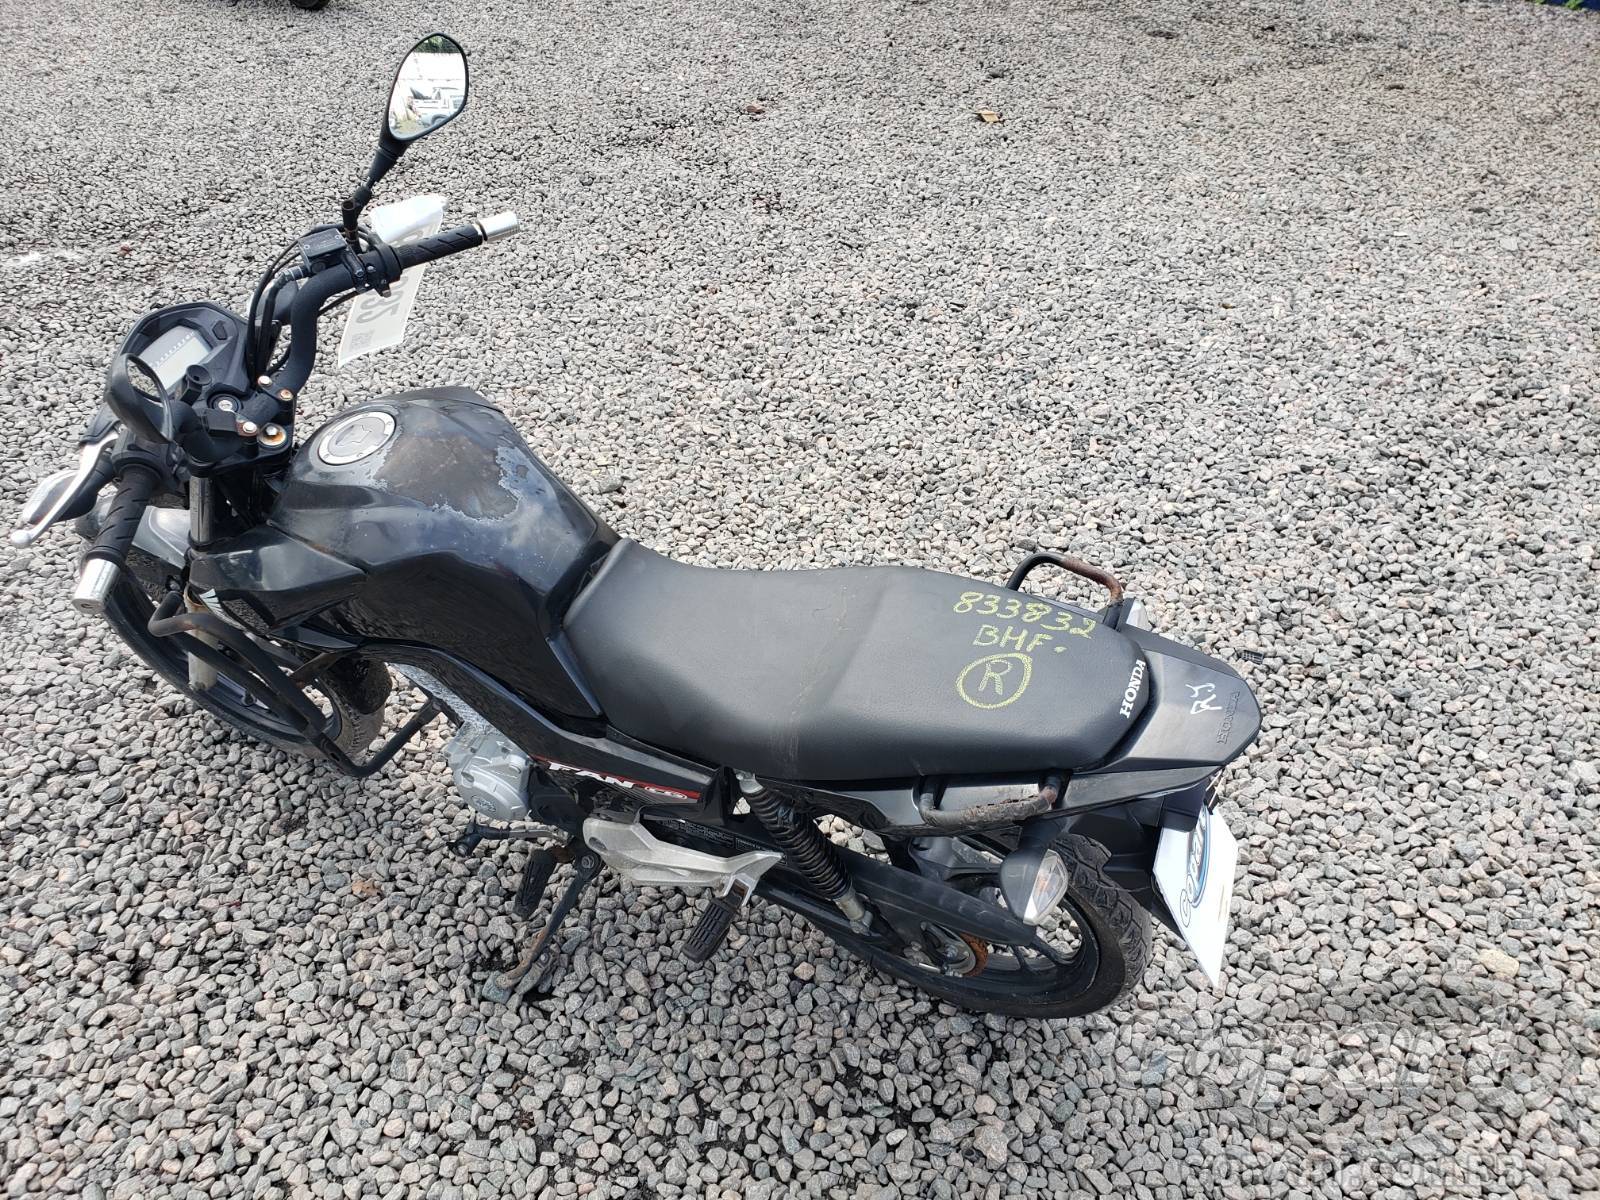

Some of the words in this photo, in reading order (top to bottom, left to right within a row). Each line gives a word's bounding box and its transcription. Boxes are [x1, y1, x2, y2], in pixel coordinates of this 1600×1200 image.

[952, 591, 1096, 639] 833832
[1119, 658, 1146, 719] HONDA
[1216, 690, 1241, 745] HONDA
[549, 761, 634, 789] FAN
